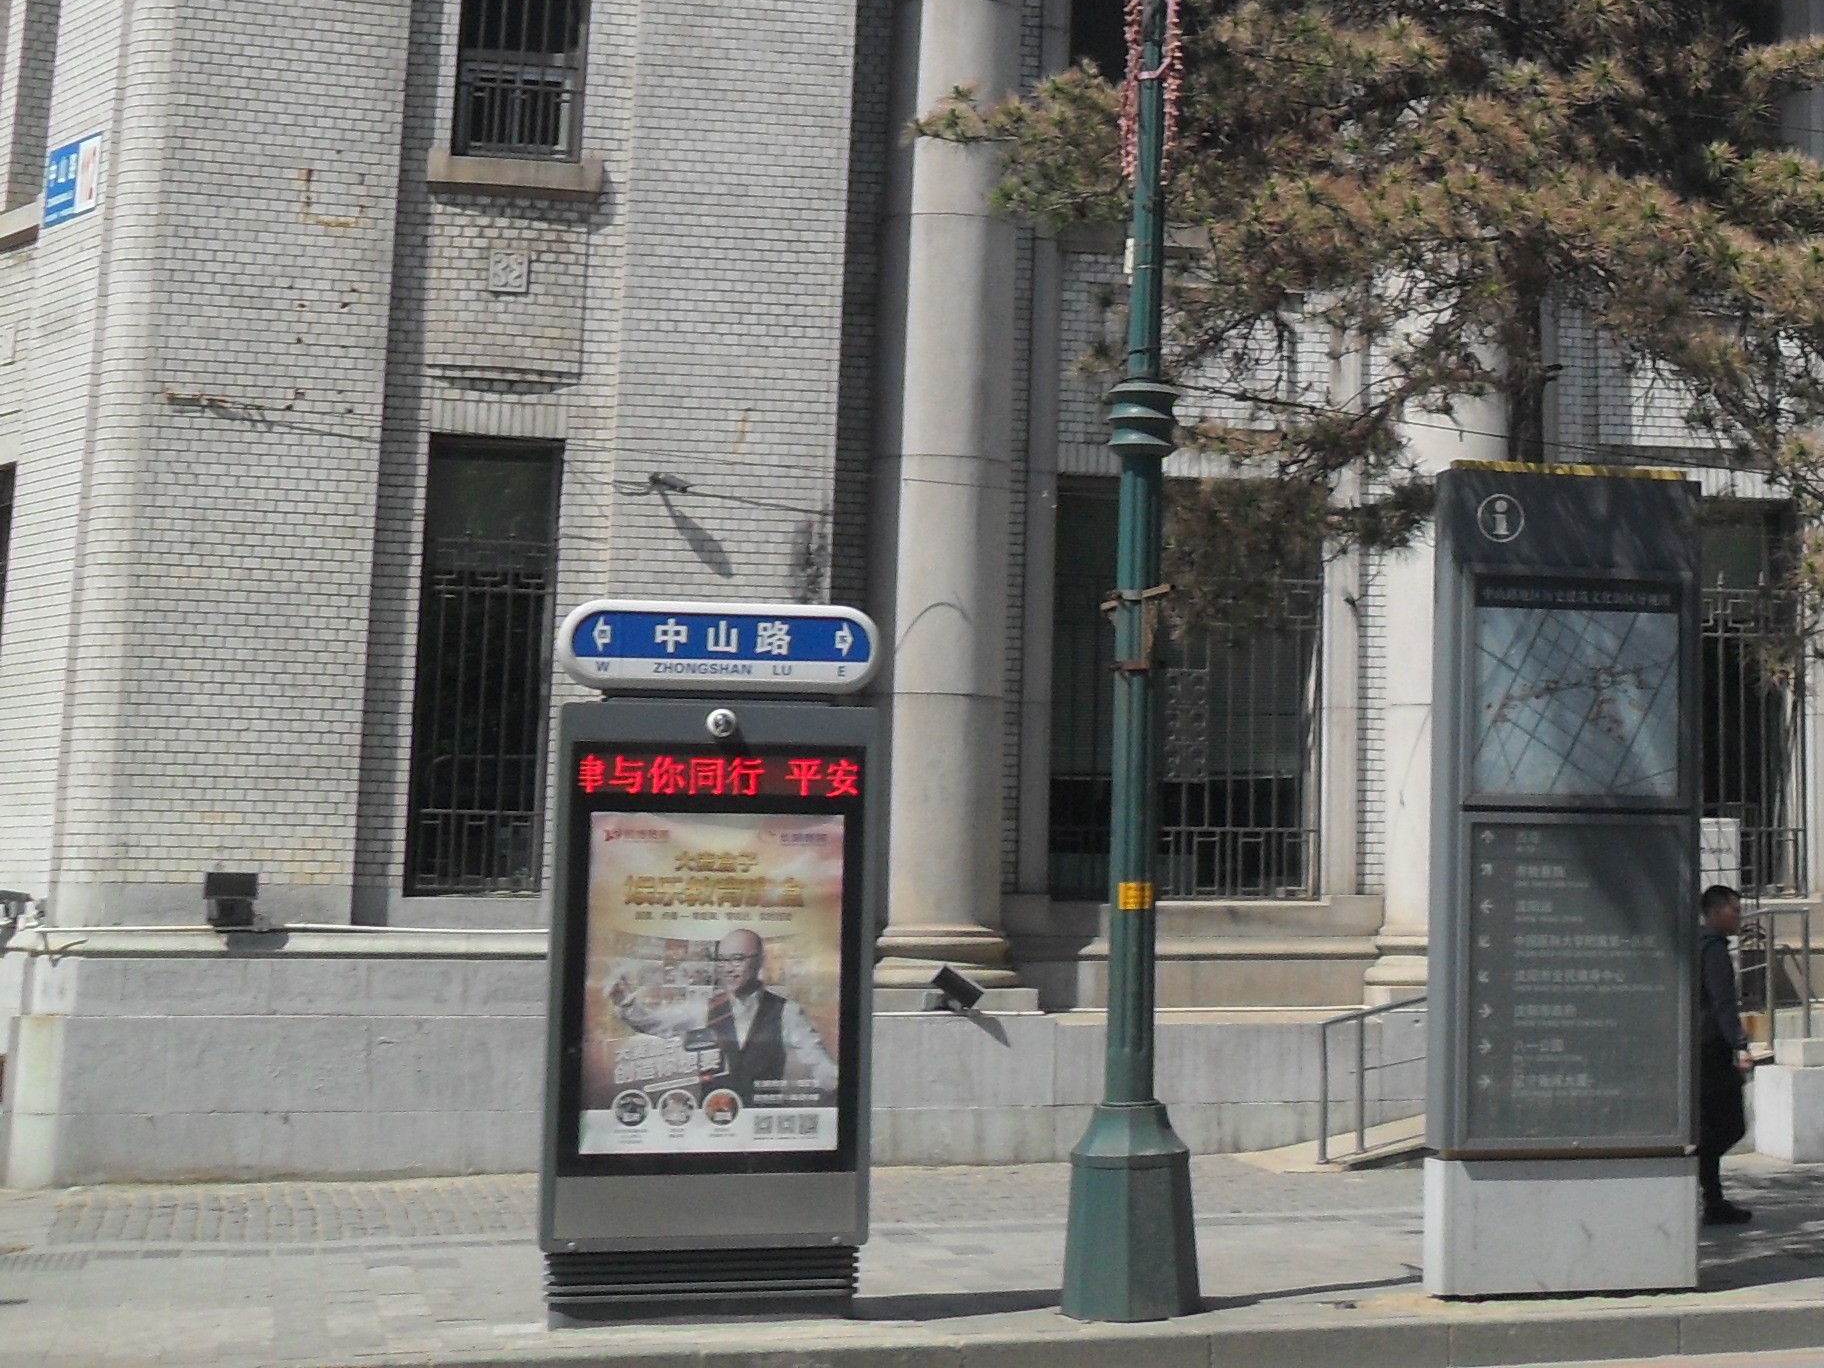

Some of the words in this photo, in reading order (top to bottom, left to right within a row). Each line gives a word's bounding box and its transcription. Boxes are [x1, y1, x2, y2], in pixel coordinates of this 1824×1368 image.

[654, 618, 792, 656] 中山路
[594, 660, 610, 672] W
[652, 661, 752, 675] ZHONGSHAN
[772, 663, 792, 676] LU
[837, 665, 846, 677] E
[784, 757, 860, 798] 平安
